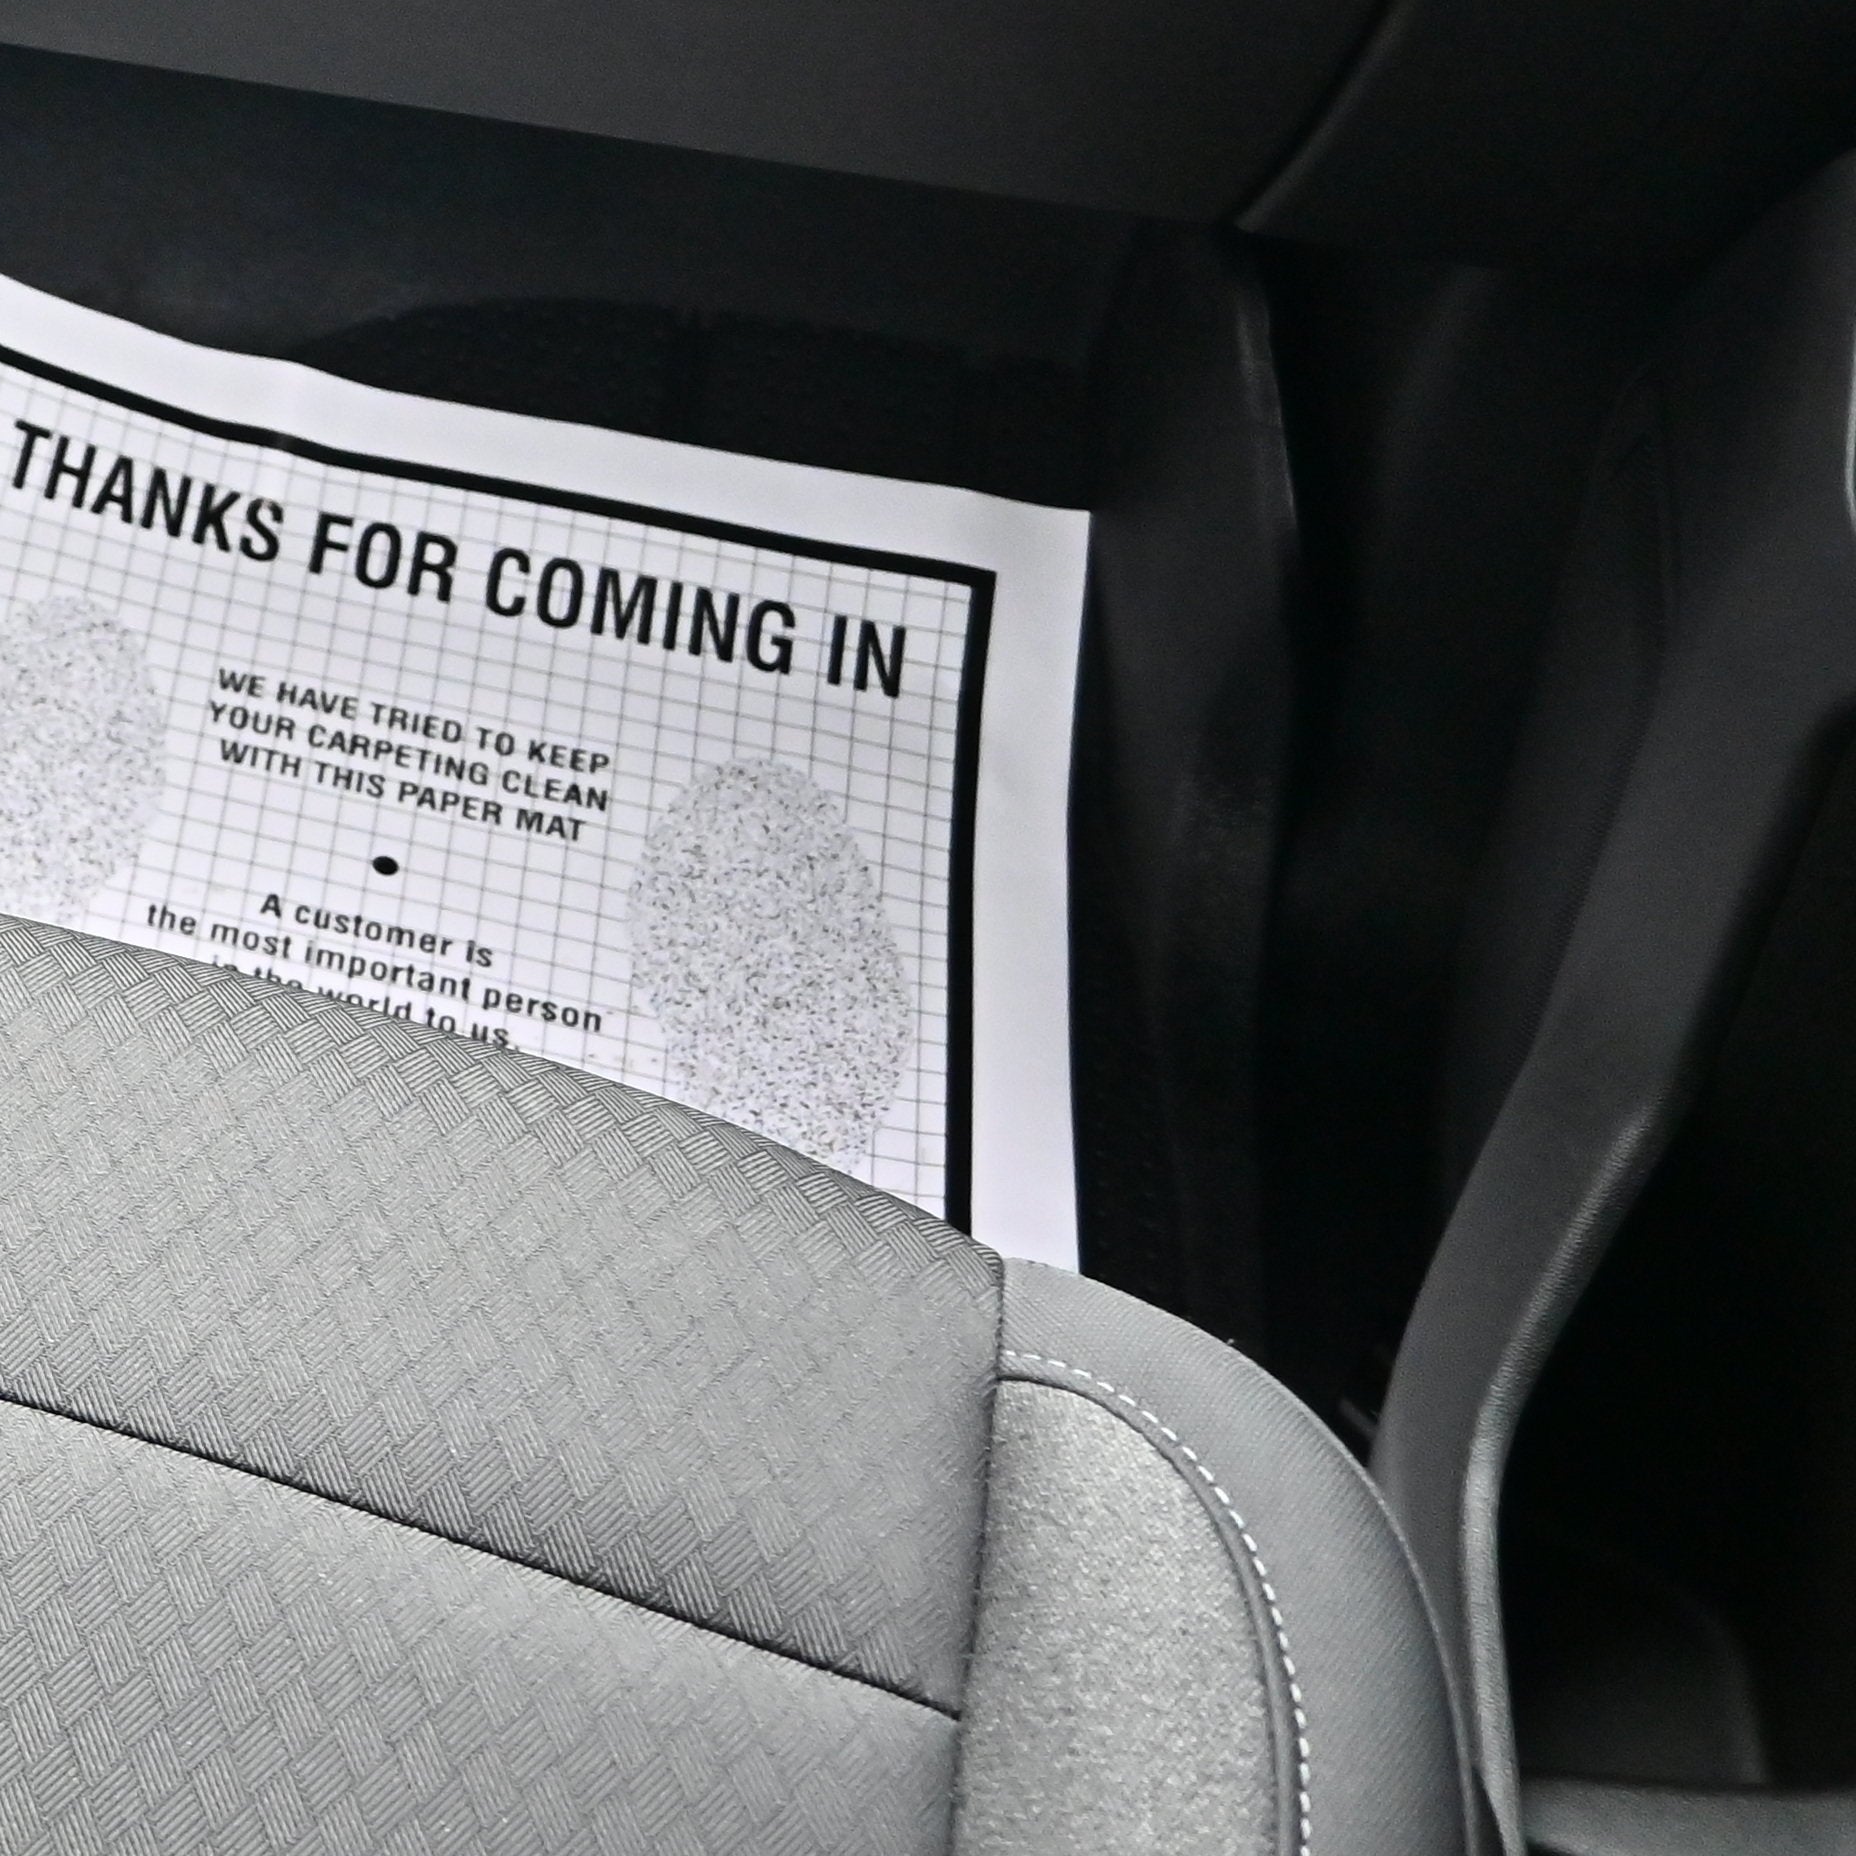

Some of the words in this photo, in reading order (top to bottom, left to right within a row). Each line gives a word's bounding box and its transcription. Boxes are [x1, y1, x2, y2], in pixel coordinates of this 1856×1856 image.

[11, 420, 283, 562] THANKS
[309, 513, 456, 604] FOR
[487, 548, 796, 675] COMING
[827, 615, 907, 699] IN
[211, 701, 295, 740] YOUR
[308, 725, 489, 787] CARPETING
[502, 772, 608, 811] CLEAN
[219, 668, 264, 697] WE
[276, 682, 358, 720] HAVE
[372, 703, 462, 742] TRIED
[478, 727, 515, 756] TO
[528, 738, 610, 774] KEEP
[220, 740, 301, 778] WITH
[316, 761, 386, 799] THIS
[398, 782, 503, 825] PAPER
[516, 808, 586, 842] MAT
[147, 905, 197, 935] the
[211, 923, 291, 959] most
[305, 945, 473, 1000] important
[484, 988, 603, 1034] person
[260, 894, 282, 918] A
[295, 905, 453, 957] customer
[466, 940, 493, 967] is
[426, 1008, 456, 1034] to
